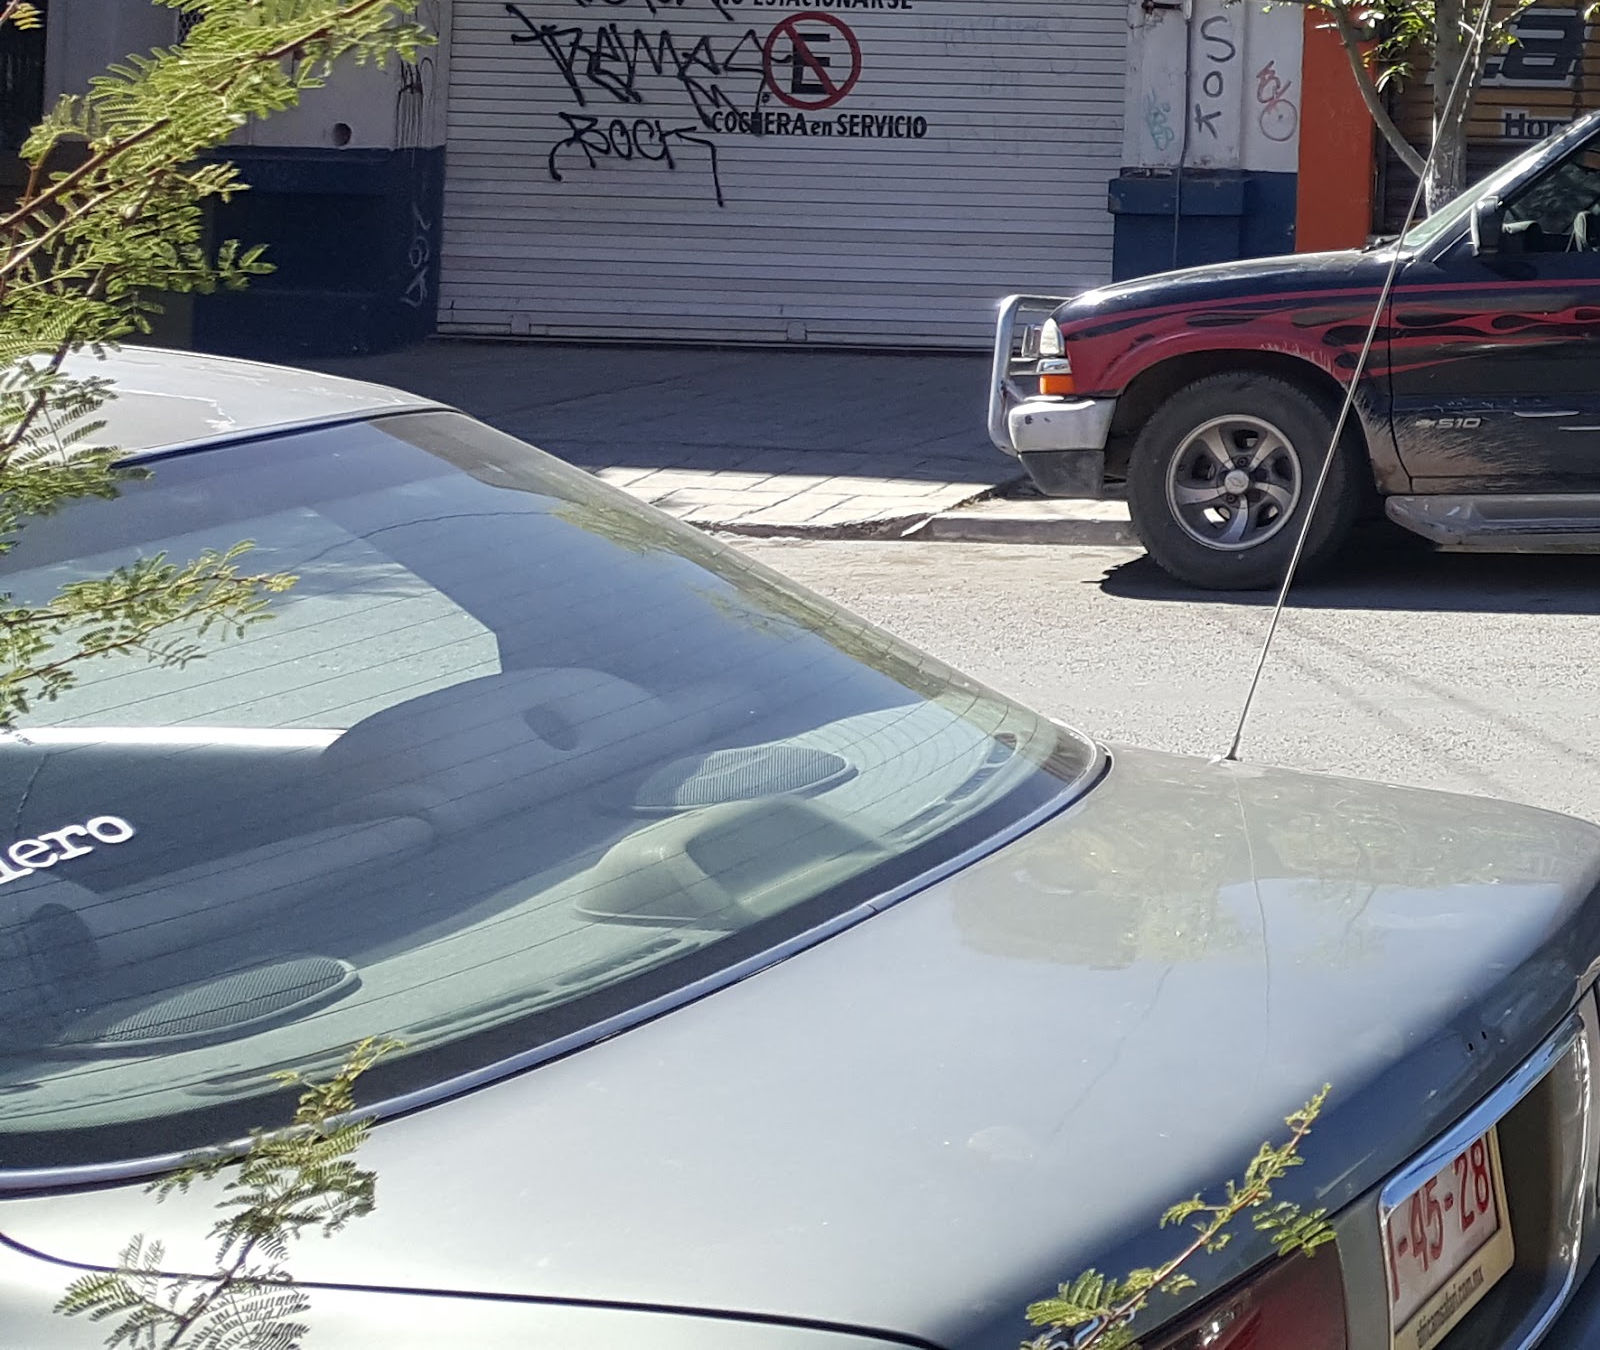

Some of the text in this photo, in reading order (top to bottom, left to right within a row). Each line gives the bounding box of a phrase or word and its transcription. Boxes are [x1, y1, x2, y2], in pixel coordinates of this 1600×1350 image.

[812, 120, 832, 136] en
[836, 112, 928, 139] SERVICIO
[1438, 417, 1482, 429] S10
